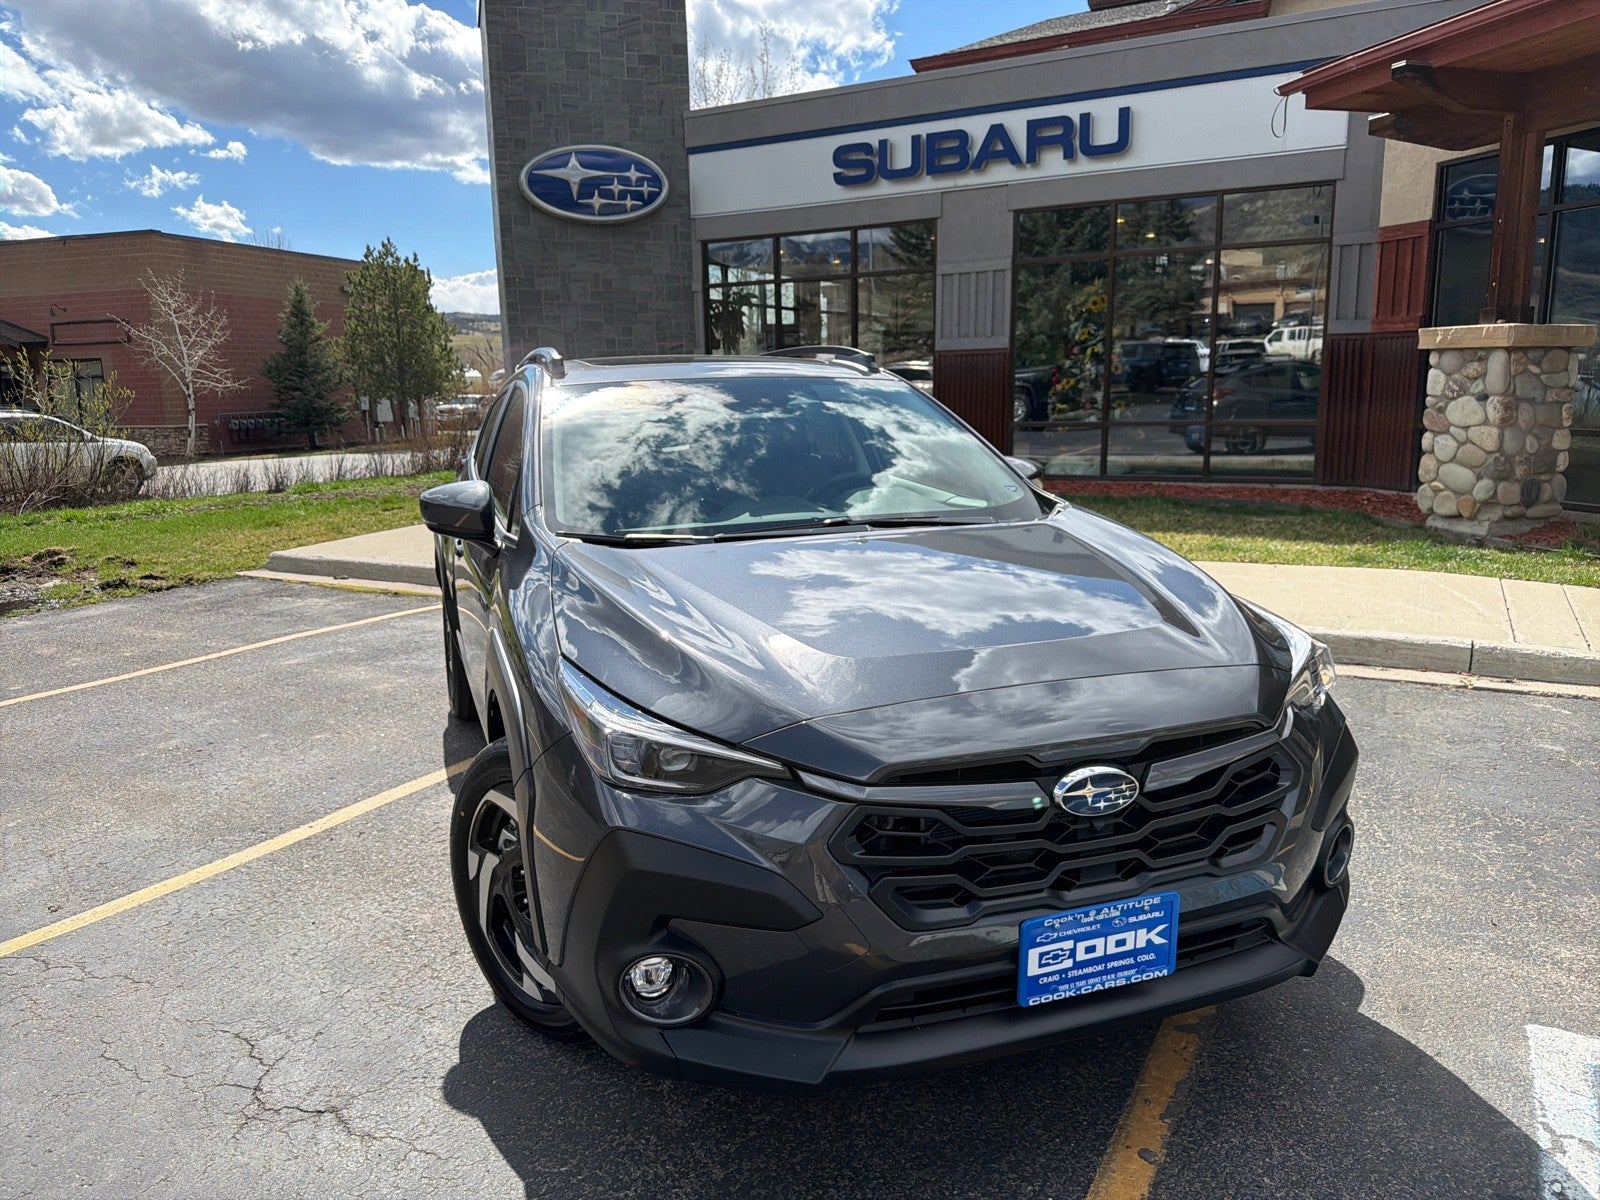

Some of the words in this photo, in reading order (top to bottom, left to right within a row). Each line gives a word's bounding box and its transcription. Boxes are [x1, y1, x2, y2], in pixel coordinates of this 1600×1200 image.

[832, 106, 1132, 187] SUBARU
[1044, 913, 1085, 927] Cook'n
[1100, 896, 1162, 917] ALTITUDE
[1059, 923, 1102, 938] CHEVROLET
[1128, 910, 1165, 924] SUBARU
[1027, 923, 1170, 977] COOK
[1038, 973, 1060, 985] CRAIG
[1067, 963, 1106, 978] STEAMBOAT
[1106, 956, 1136, 970] SPRINGS,
[1136, 952, 1157, 963] COLO.
[1028, 968, 1168, 1007] COOK-CARS.COM
